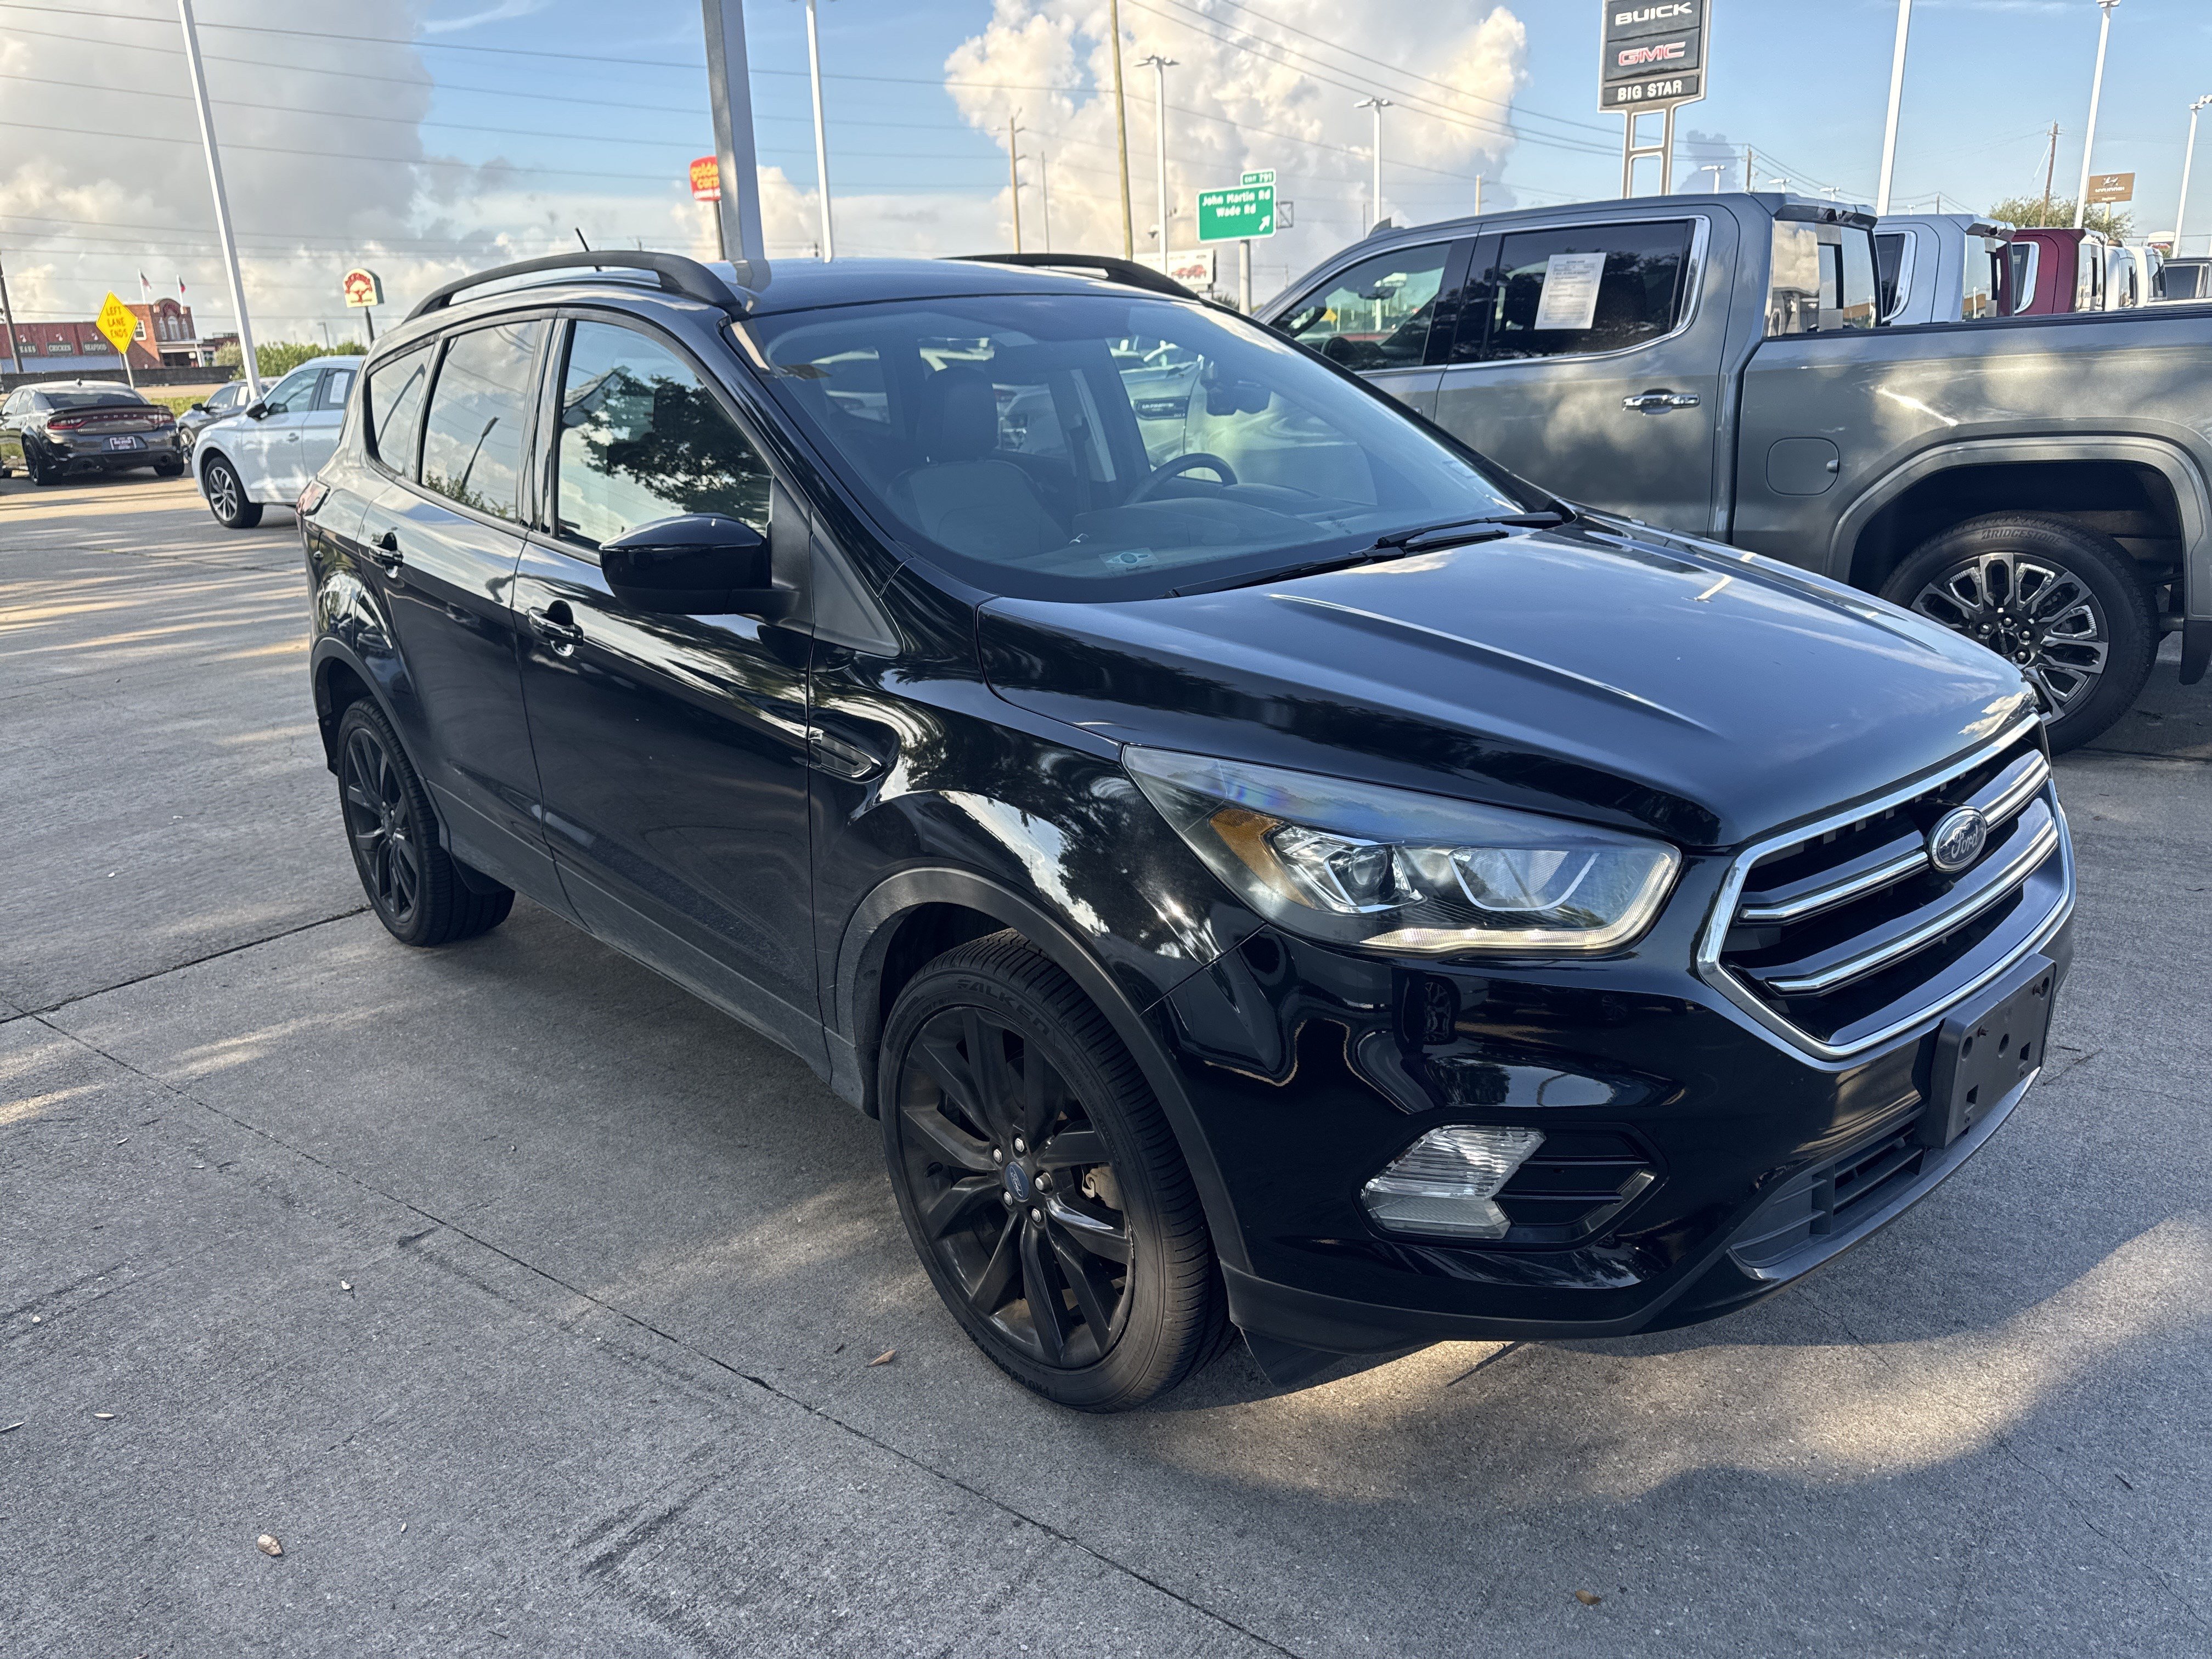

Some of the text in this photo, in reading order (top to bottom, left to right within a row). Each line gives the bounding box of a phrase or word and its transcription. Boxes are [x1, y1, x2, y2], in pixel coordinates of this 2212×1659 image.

[1615, 2, 1693, 26] BUICK
[1618, 41, 1686, 66] GMC
[1617, 80, 1683, 101] BIG STAR
[1202, 188, 1271, 207] John Martin Rd
[1216, 202, 1257, 218] Wade Rd
[105, 306, 122, 317] LEFT
[107, 317, 126, 328] LANE
[110, 329, 128, 338] ENDS
[1951, 825, 1979, 859] Ford
[956, 979, 1050, 1036] FALKEN
[1028, 1379, 1049, 1396] PRO
